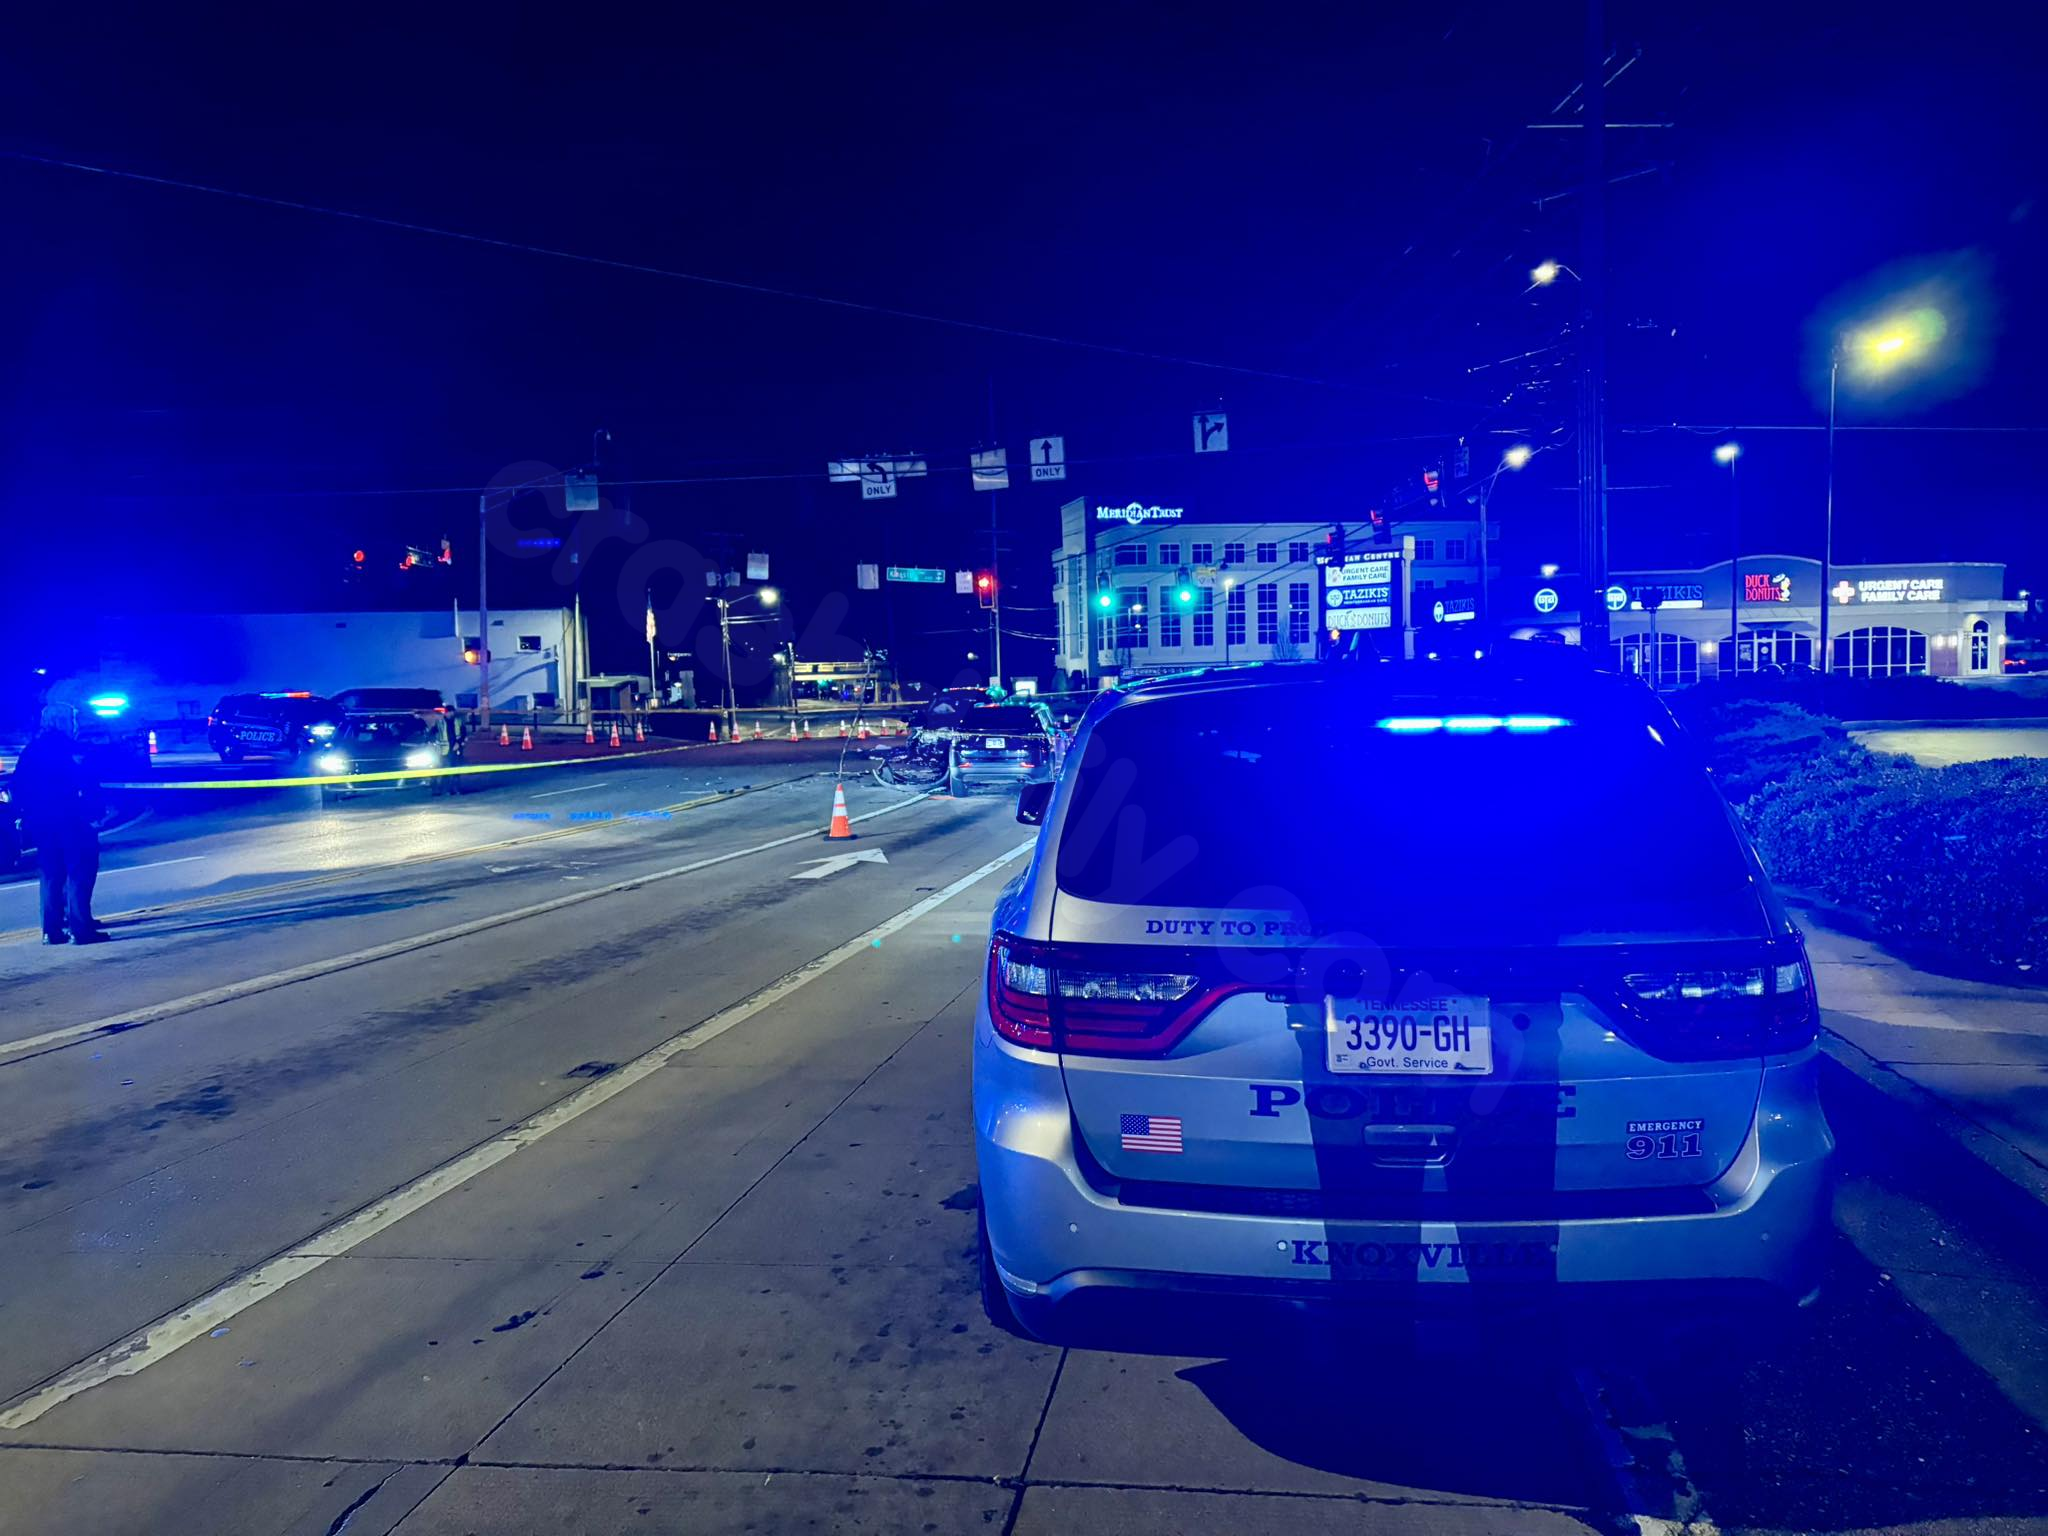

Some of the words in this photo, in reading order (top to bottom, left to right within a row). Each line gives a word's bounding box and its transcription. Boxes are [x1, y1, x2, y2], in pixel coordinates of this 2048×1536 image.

[1035, 468, 1060, 478] ONLY
[866, 485, 891, 496] ONLY
[1364, 552, 1399, 560] CENTRE
[1370, 565, 1388, 573] CARE
[1745, 574, 1770, 587] DUCK
[1859, 580, 1908, 591] URGENT
[1909, 579, 1943, 590] CARE
[1745, 588, 1781, 601] DONUTS
[1861, 591, 1905, 601] FAMILY
[1907, 590, 1940, 600] CARE
[1357, 613, 1389, 625] DONUTS
[240, 731, 276, 742] POLICE
[1146, 920, 1212, 937] DUTY
[1220, 920, 1257, 936] TO
[1363, 999, 1448, 1011] TENNESSEE
[1346, 1015, 1470, 1052] 3390-GH
[1367, 1057, 1399, 1069] Govt.
[1403, 1057, 1448, 1068] Service
[1629, 1121, 1702, 1132] EMERGENCY
[1626, 1133, 1703, 1160] 911
[1291, 1240, 1548, 1267] KNOXVILLE
